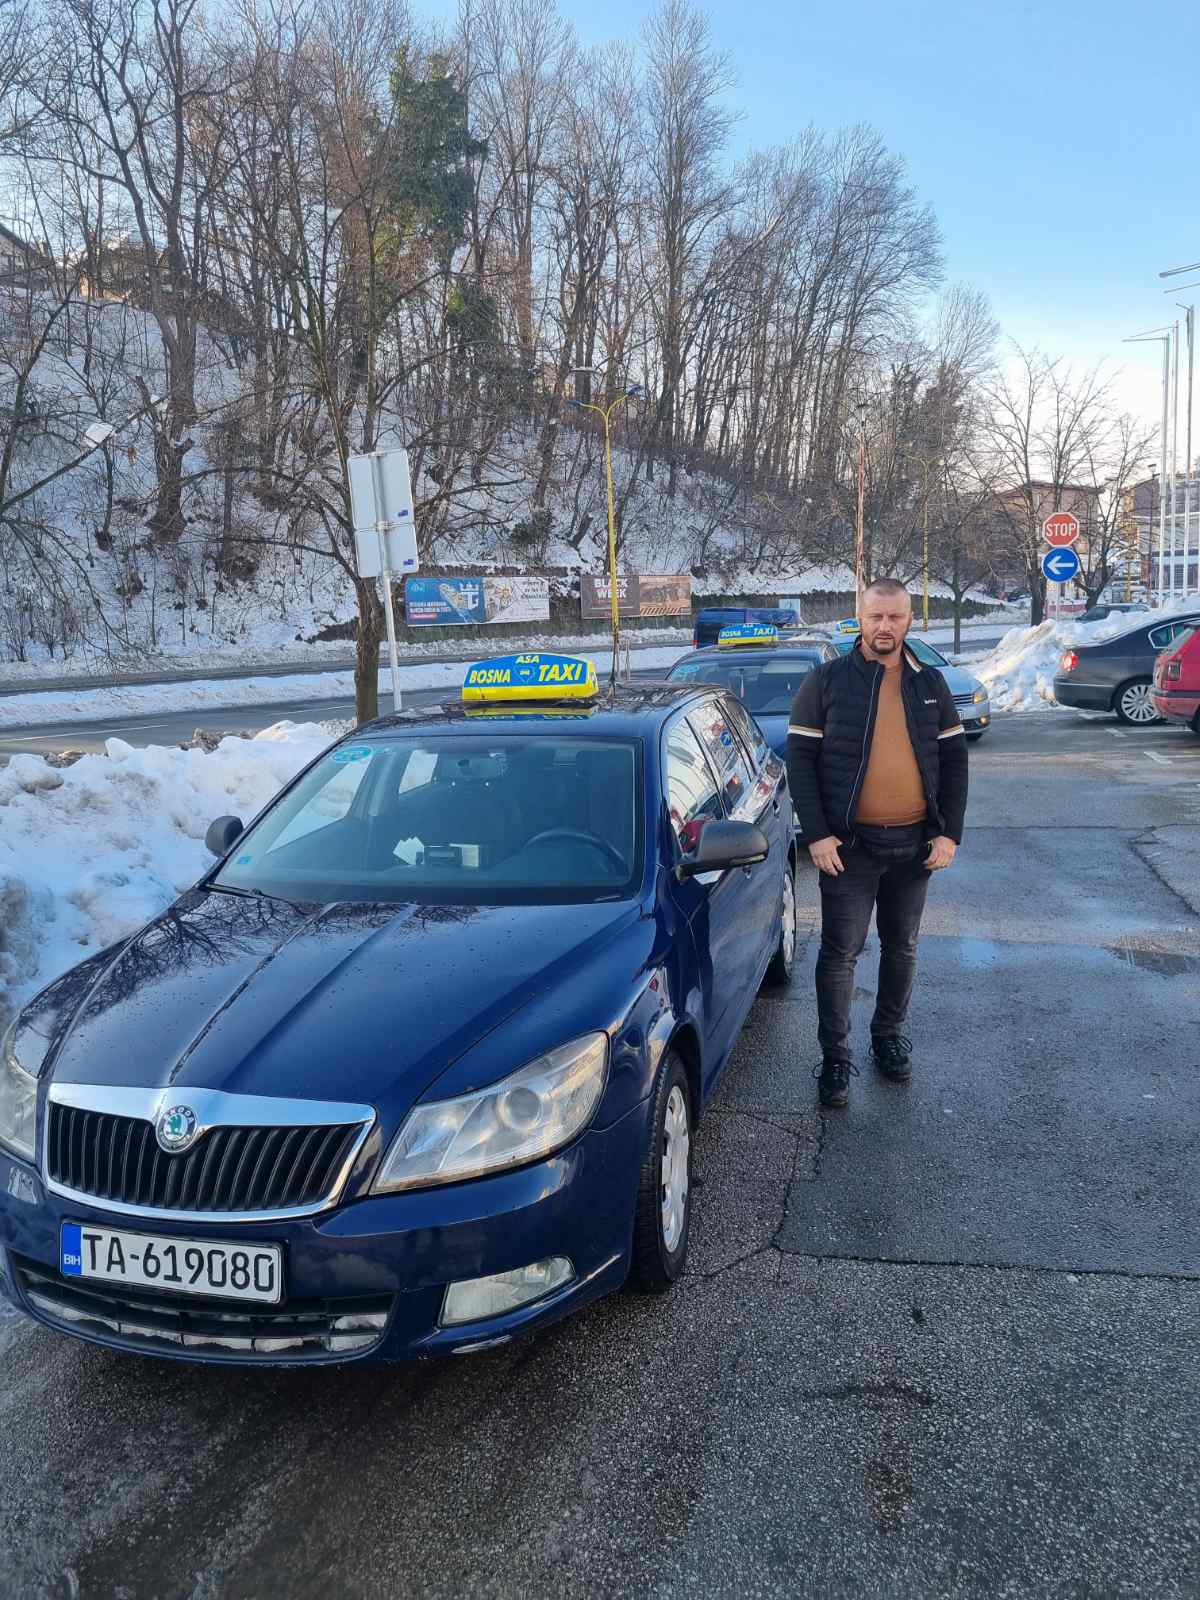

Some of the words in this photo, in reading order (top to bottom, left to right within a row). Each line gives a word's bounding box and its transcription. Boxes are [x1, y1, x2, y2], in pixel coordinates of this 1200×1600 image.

[1046, 523, 1076, 537] STOP
[753, 627, 774, 636] TAXI
[515, 655, 540, 664] ASA
[469, 669, 511, 684] BOSNA
[538, 663, 583, 682] TAXI
[64, 1255, 81, 1266] BIH
[83, 1234, 275, 1292] TA-619080
